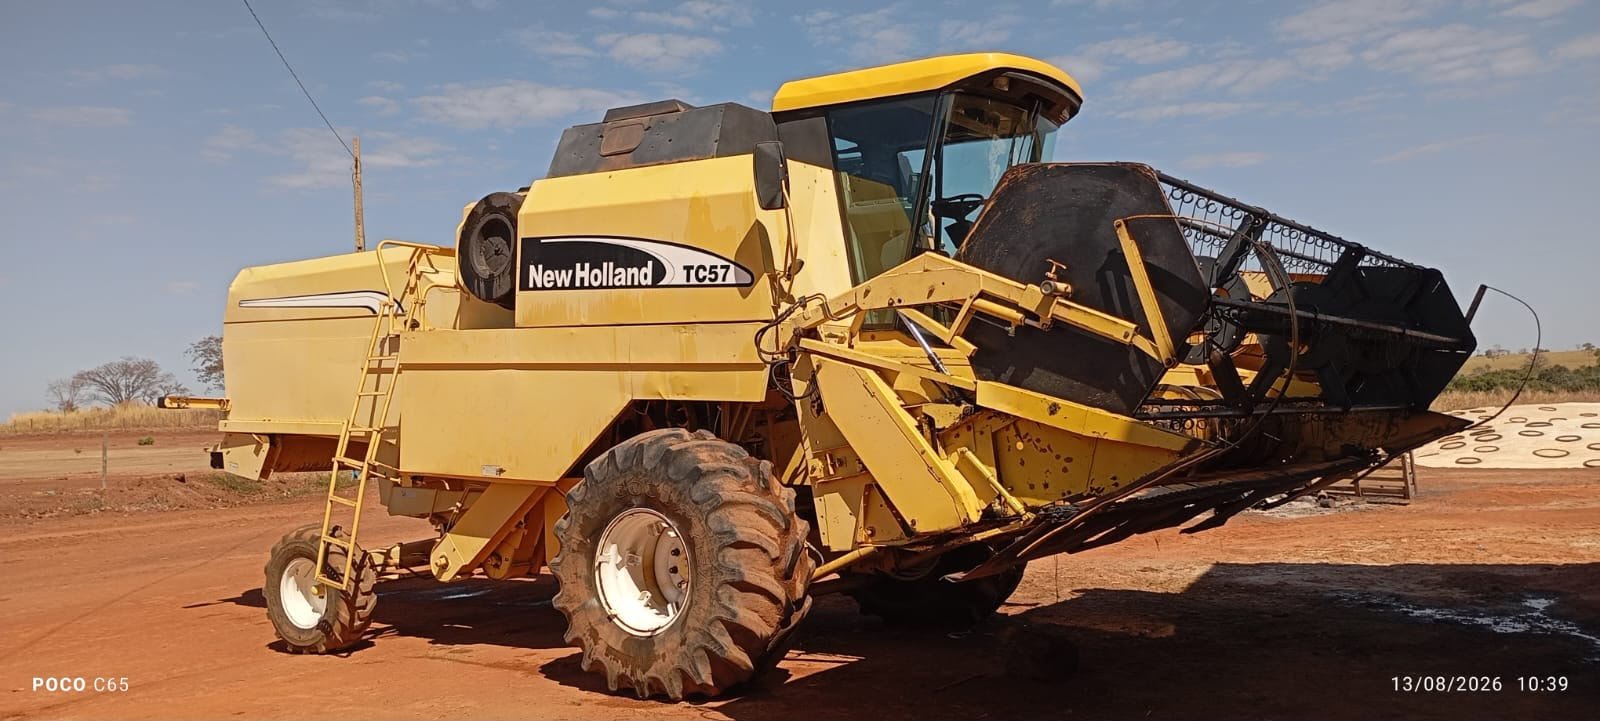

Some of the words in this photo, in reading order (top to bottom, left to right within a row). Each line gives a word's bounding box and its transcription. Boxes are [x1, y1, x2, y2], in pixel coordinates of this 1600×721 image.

[528, 264, 573, 288] New
[575, 260, 653, 287] Holland
[683, 264, 731, 283] TC57
